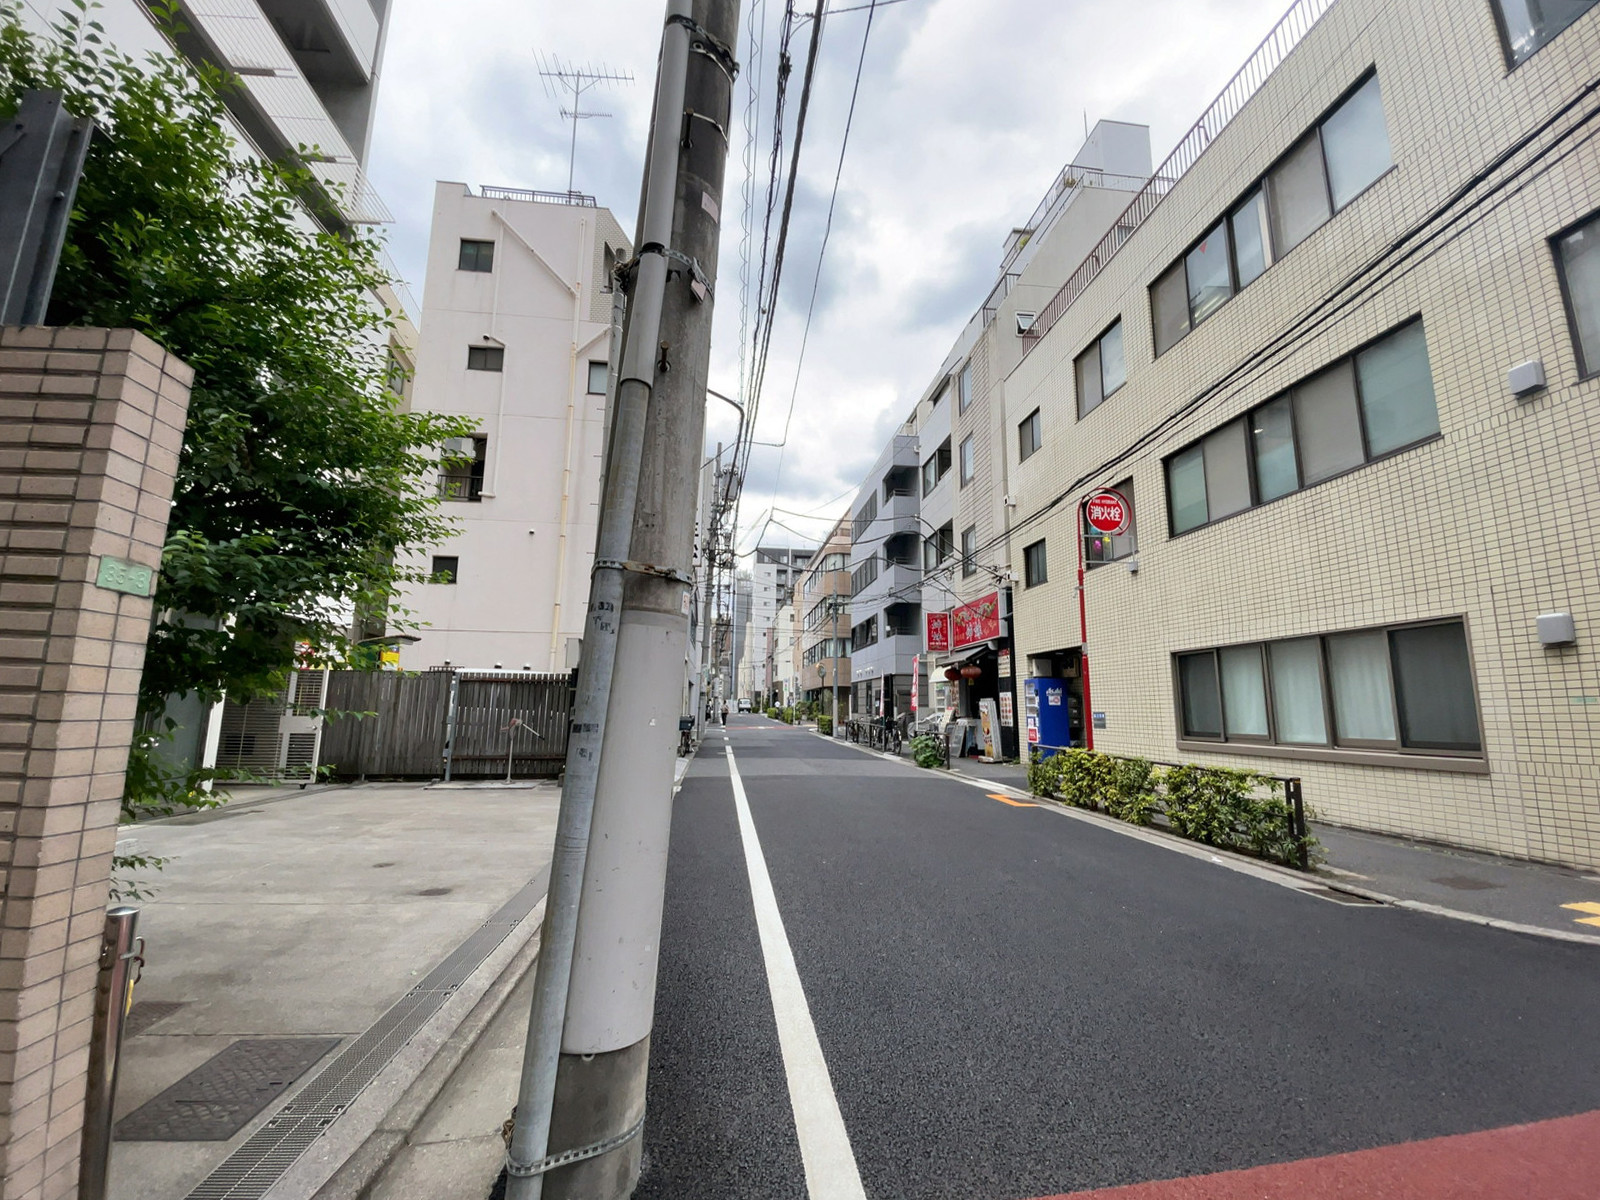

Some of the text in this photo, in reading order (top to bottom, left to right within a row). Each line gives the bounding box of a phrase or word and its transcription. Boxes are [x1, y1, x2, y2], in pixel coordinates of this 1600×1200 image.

[1090, 505, 1121, 521] 消火栓
[105, 564, 147, 589] 35-3
